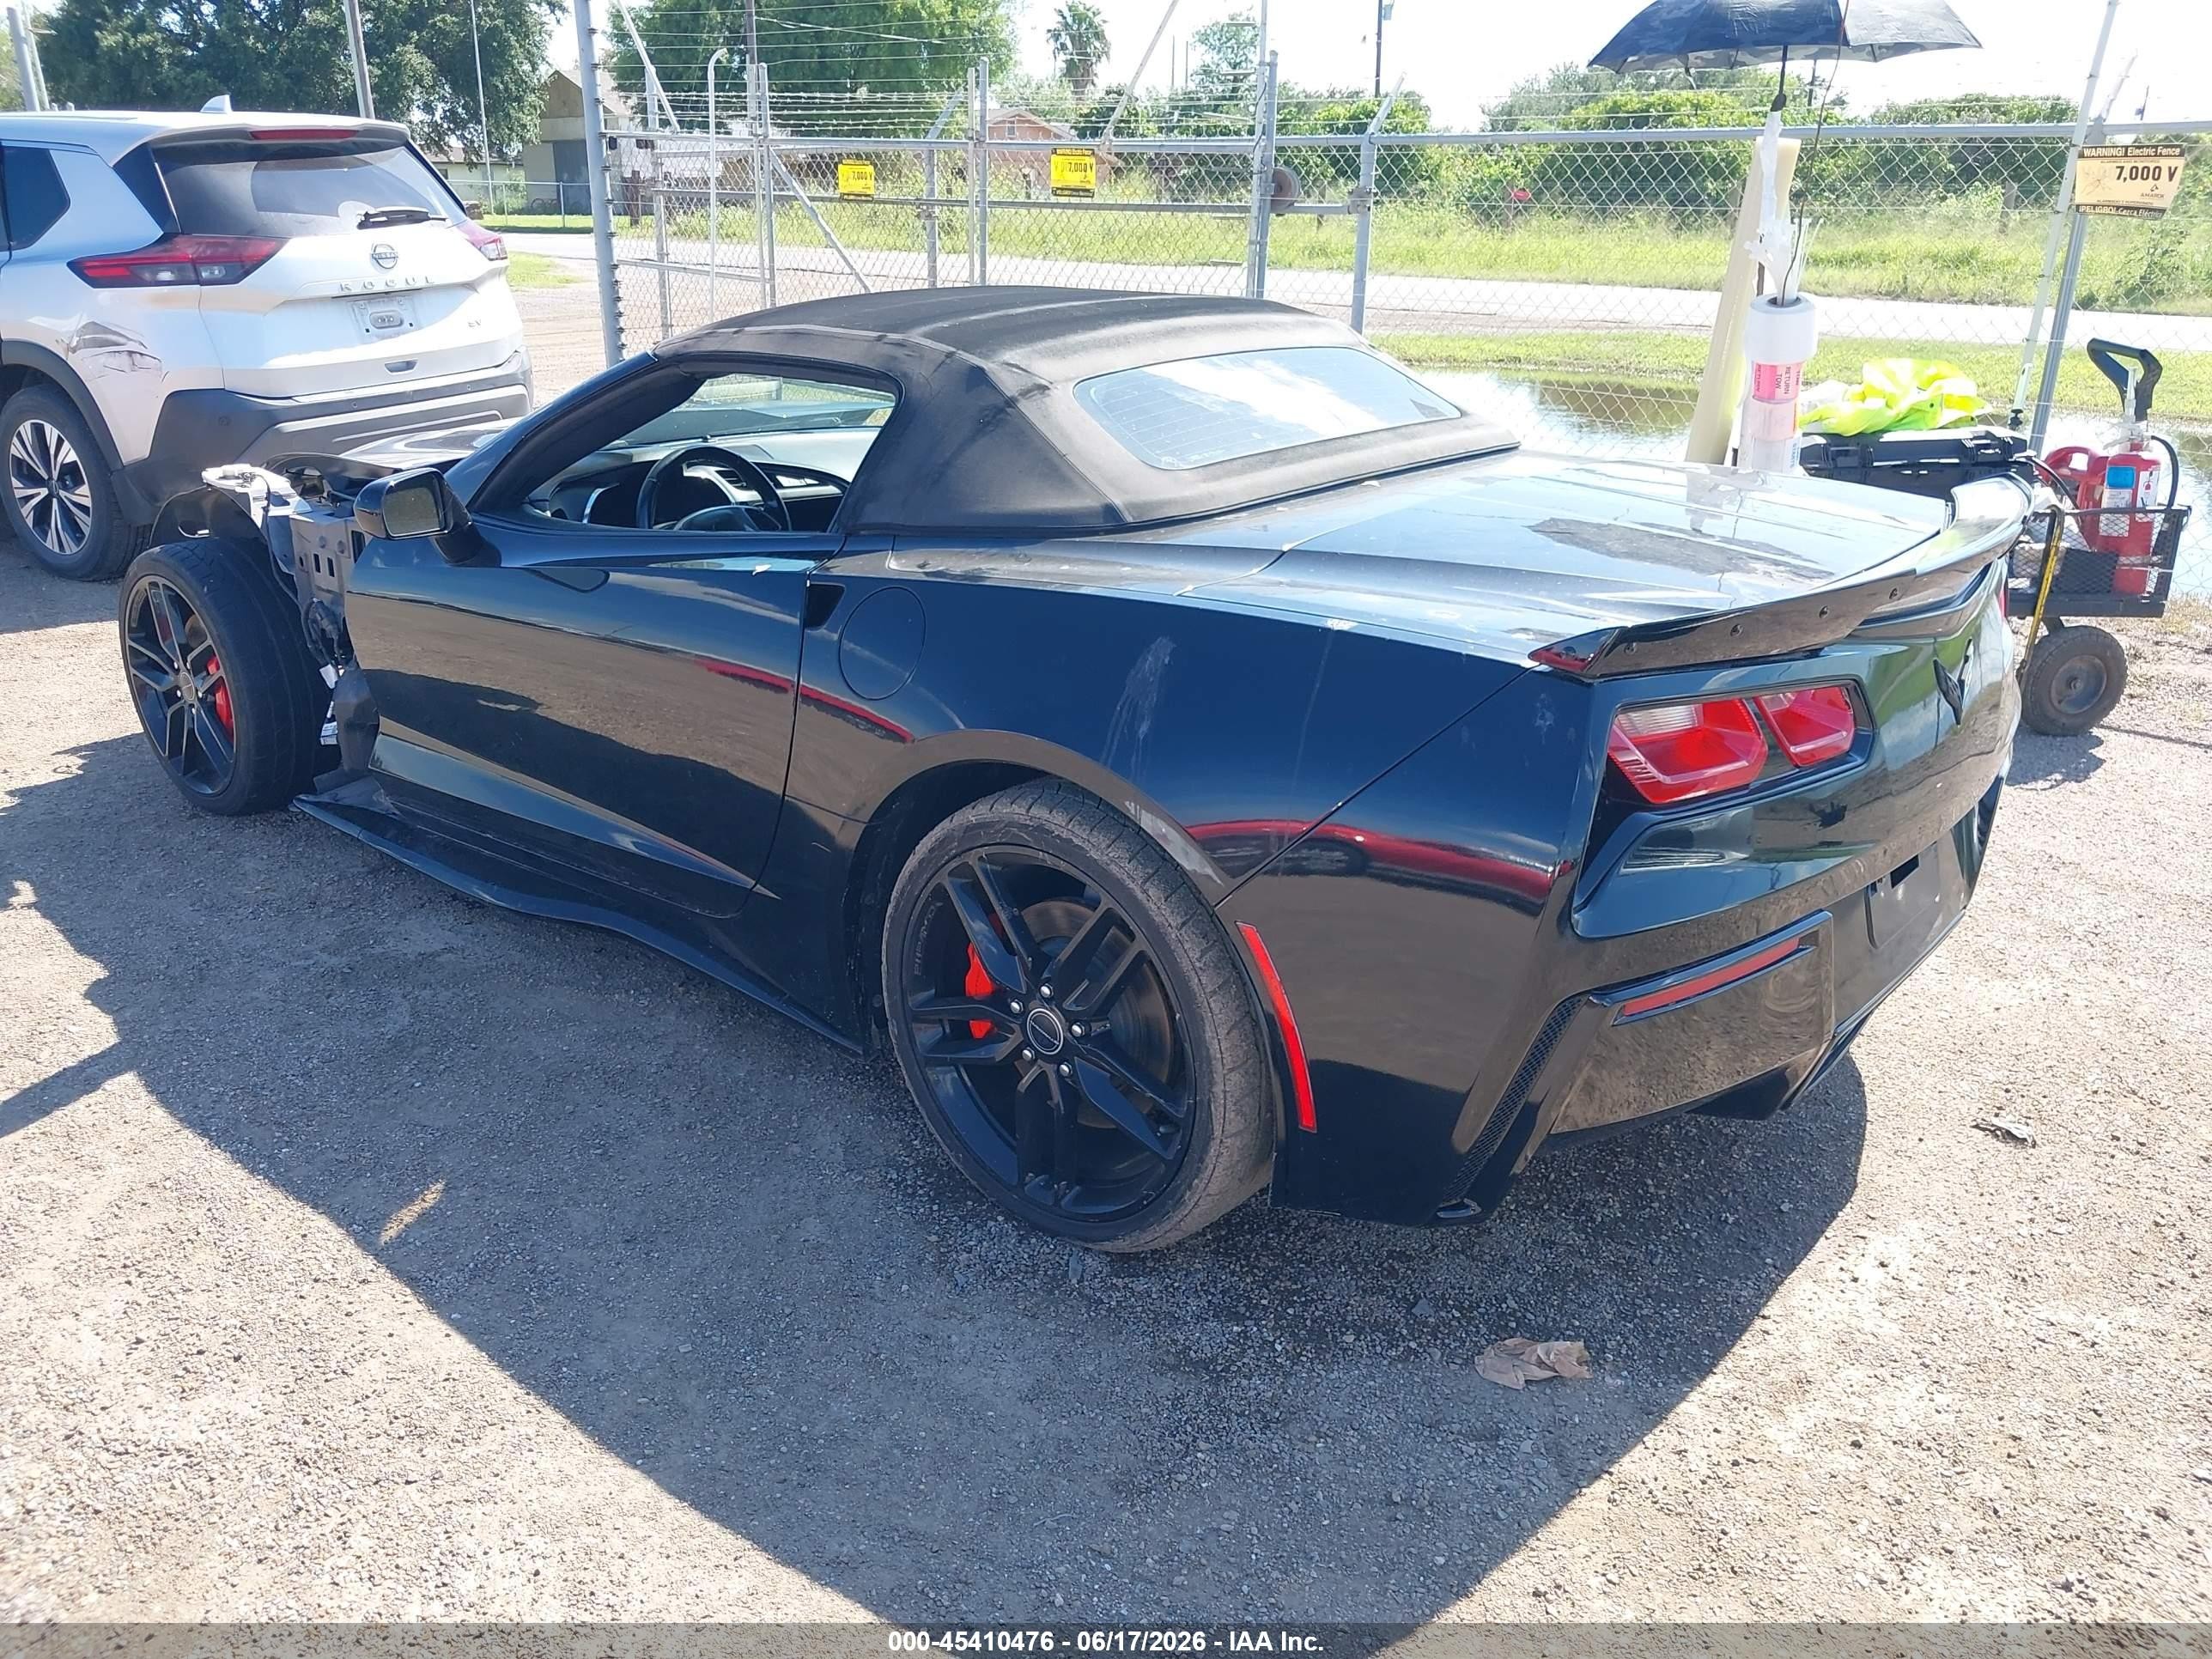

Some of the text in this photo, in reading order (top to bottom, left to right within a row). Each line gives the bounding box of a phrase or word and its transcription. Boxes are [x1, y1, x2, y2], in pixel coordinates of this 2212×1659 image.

[2083, 146, 2181, 156] WARNING! Electric Fence
[1067, 162, 1087, 173] 7,000
[2115, 166, 2179, 183] 7,000 V
